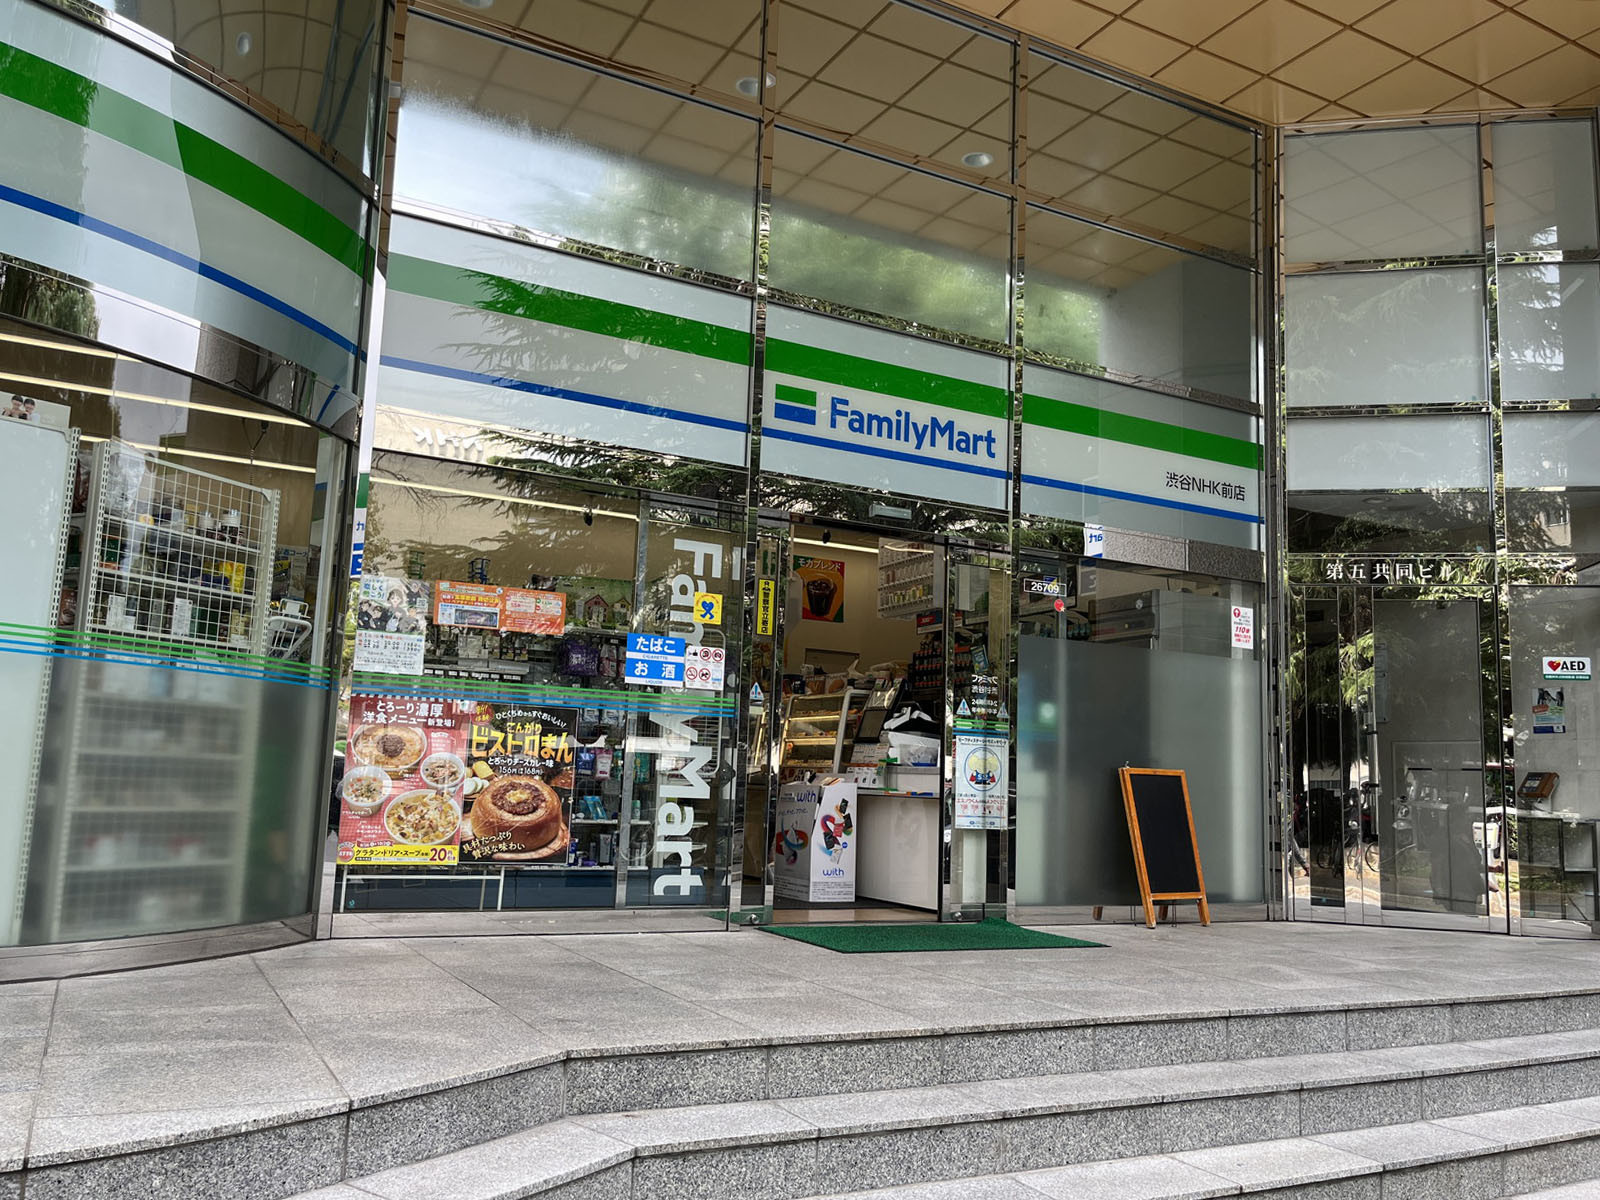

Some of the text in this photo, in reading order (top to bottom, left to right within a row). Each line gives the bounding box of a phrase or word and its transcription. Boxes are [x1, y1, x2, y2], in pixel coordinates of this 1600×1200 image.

[829, 396, 997, 460] FamilyMart
[1165, 470, 1246, 503] 渋谷NHK前店
[797, 557, 842, 571] モカブレンド
[1325, 562, 1458, 581] 第五共同ビル
[1031, 581, 1060, 594] 26709
[636, 636, 676, 654] たばこ
[1561, 660, 1586, 671] AED
[376, 700, 444, 718] とろーり濃厚
[506, 721, 543, 734] こんがり
[471, 725, 573, 764] ビストロまん
[797, 790, 817, 803] with
[462, 831, 512, 854] 具材たっぷり
[472, 841, 526, 860] 贅沢な味わい
[823, 868, 844, 877] with
